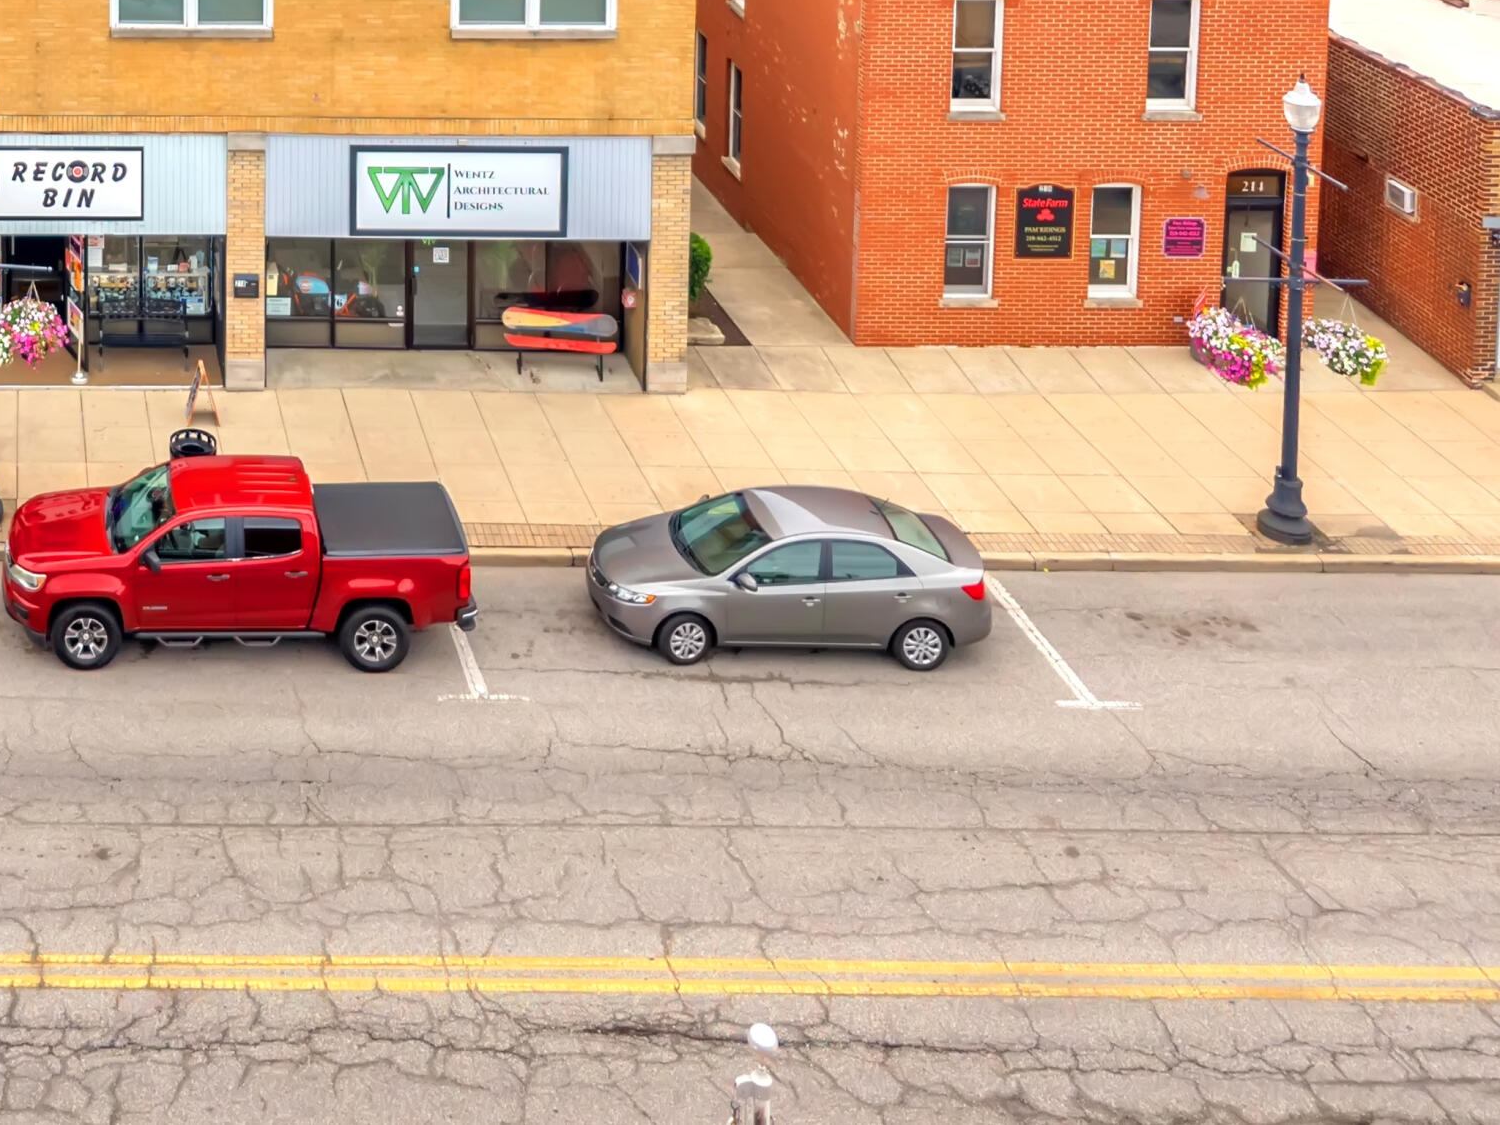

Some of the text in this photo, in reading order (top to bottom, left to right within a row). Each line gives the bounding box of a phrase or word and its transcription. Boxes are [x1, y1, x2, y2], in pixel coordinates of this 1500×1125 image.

[11, 160, 128, 183] RECORD
[453, 185, 550, 196] ARCHITECTURAL
[1242, 180, 1263, 192] 214
[42, 187, 95, 208] BIN
[1022, 198, 1068, 208] State Farm
[454, 201, 503, 211] DESIGNS
